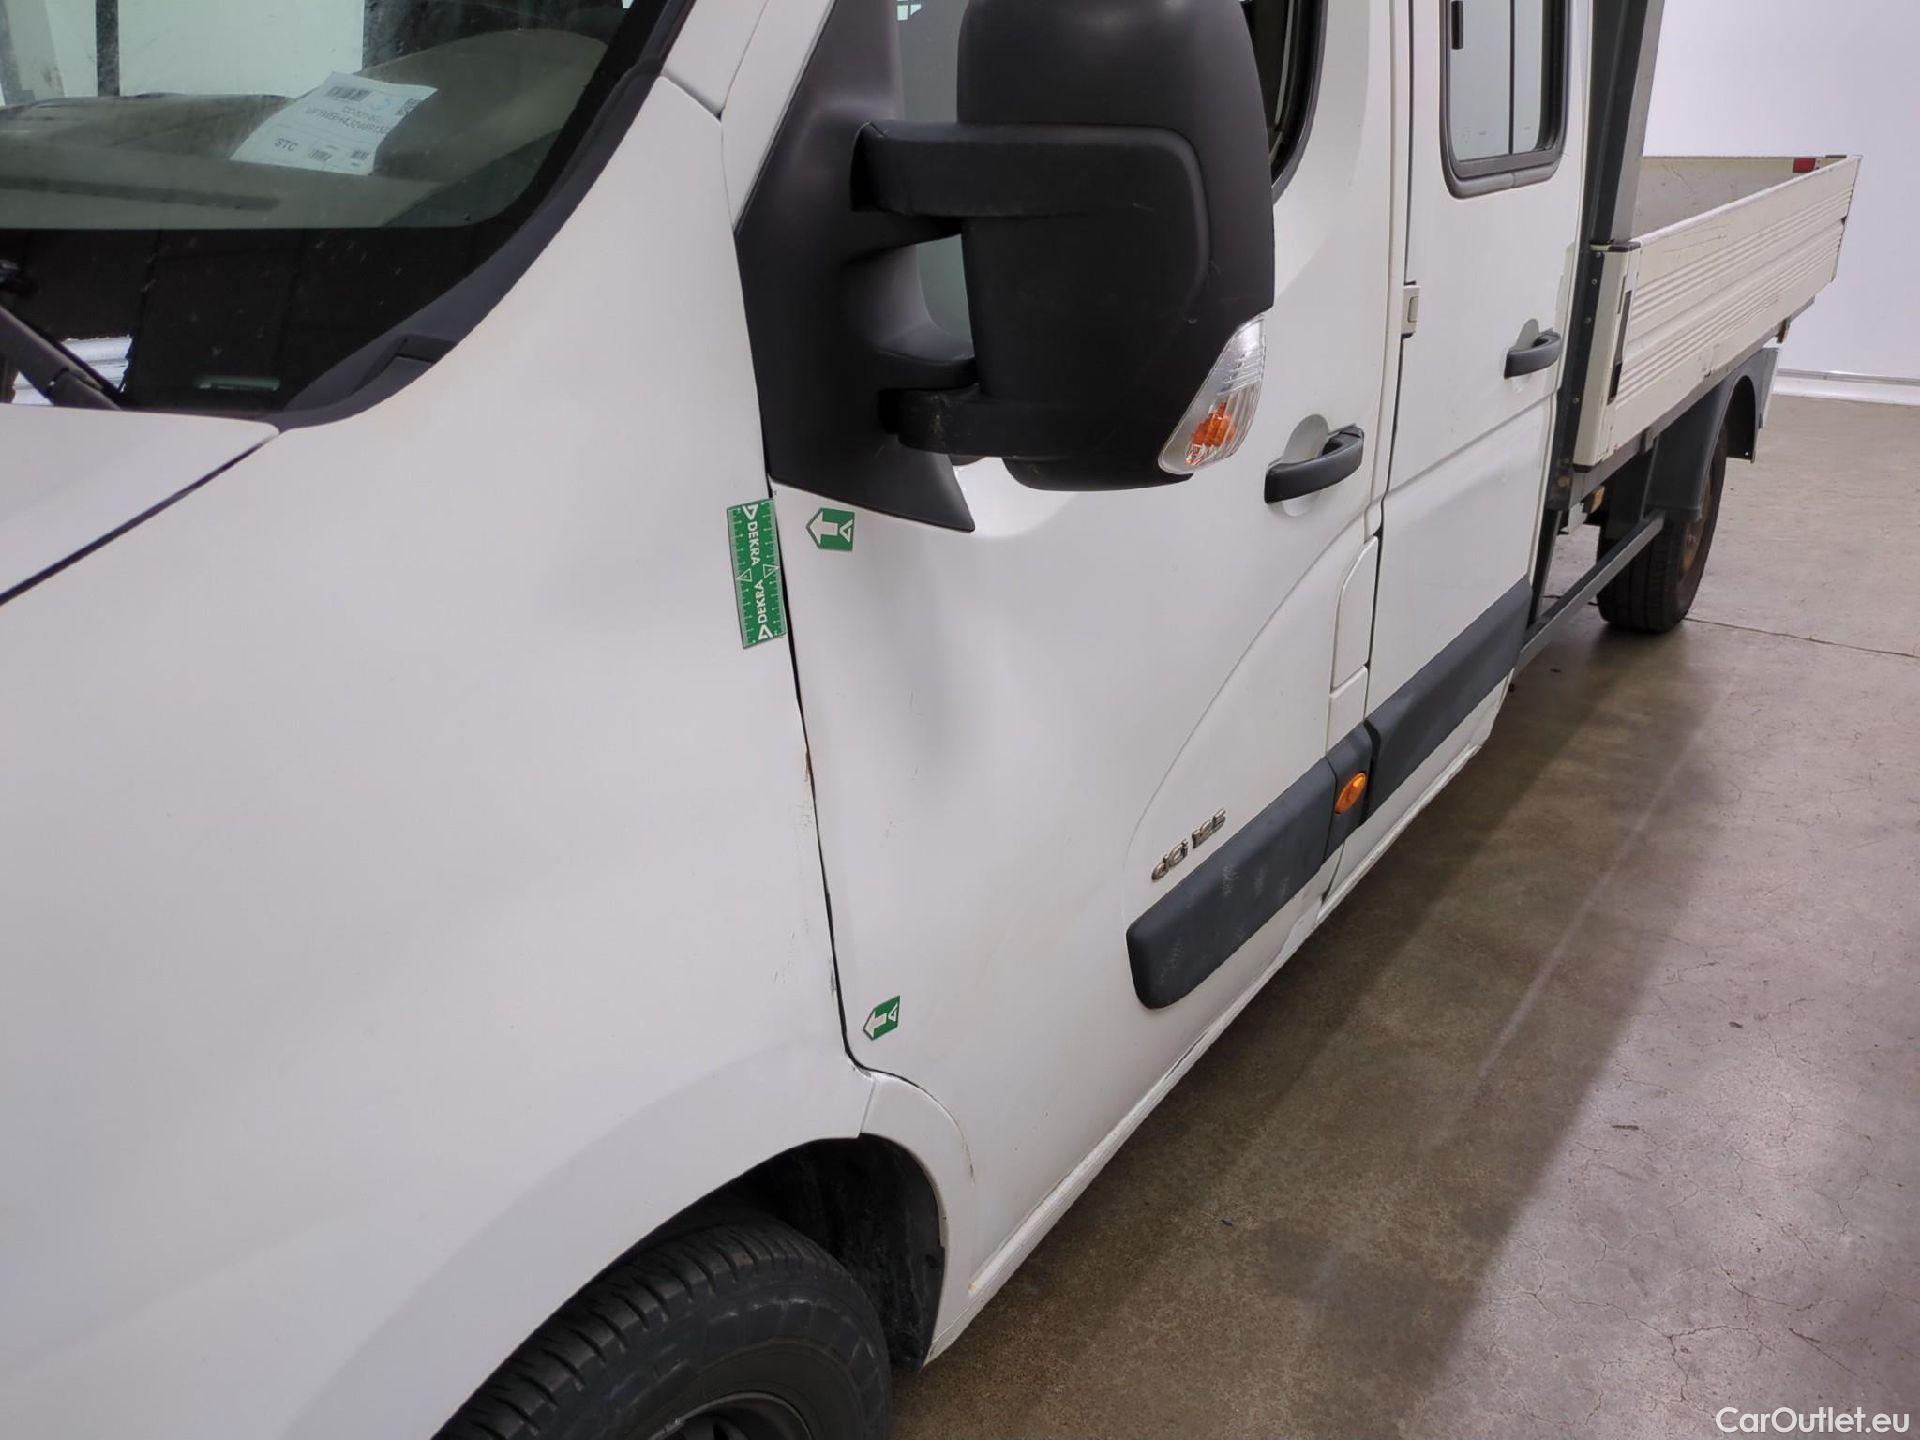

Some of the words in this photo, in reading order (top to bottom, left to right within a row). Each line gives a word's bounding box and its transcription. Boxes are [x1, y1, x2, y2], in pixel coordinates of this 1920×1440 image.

[274, 138, 299, 152] STC
[747, 520, 761, 566] DEKRA
[755, 579, 768, 624] DEKRA
[1191, 807, 1227, 849] 125
